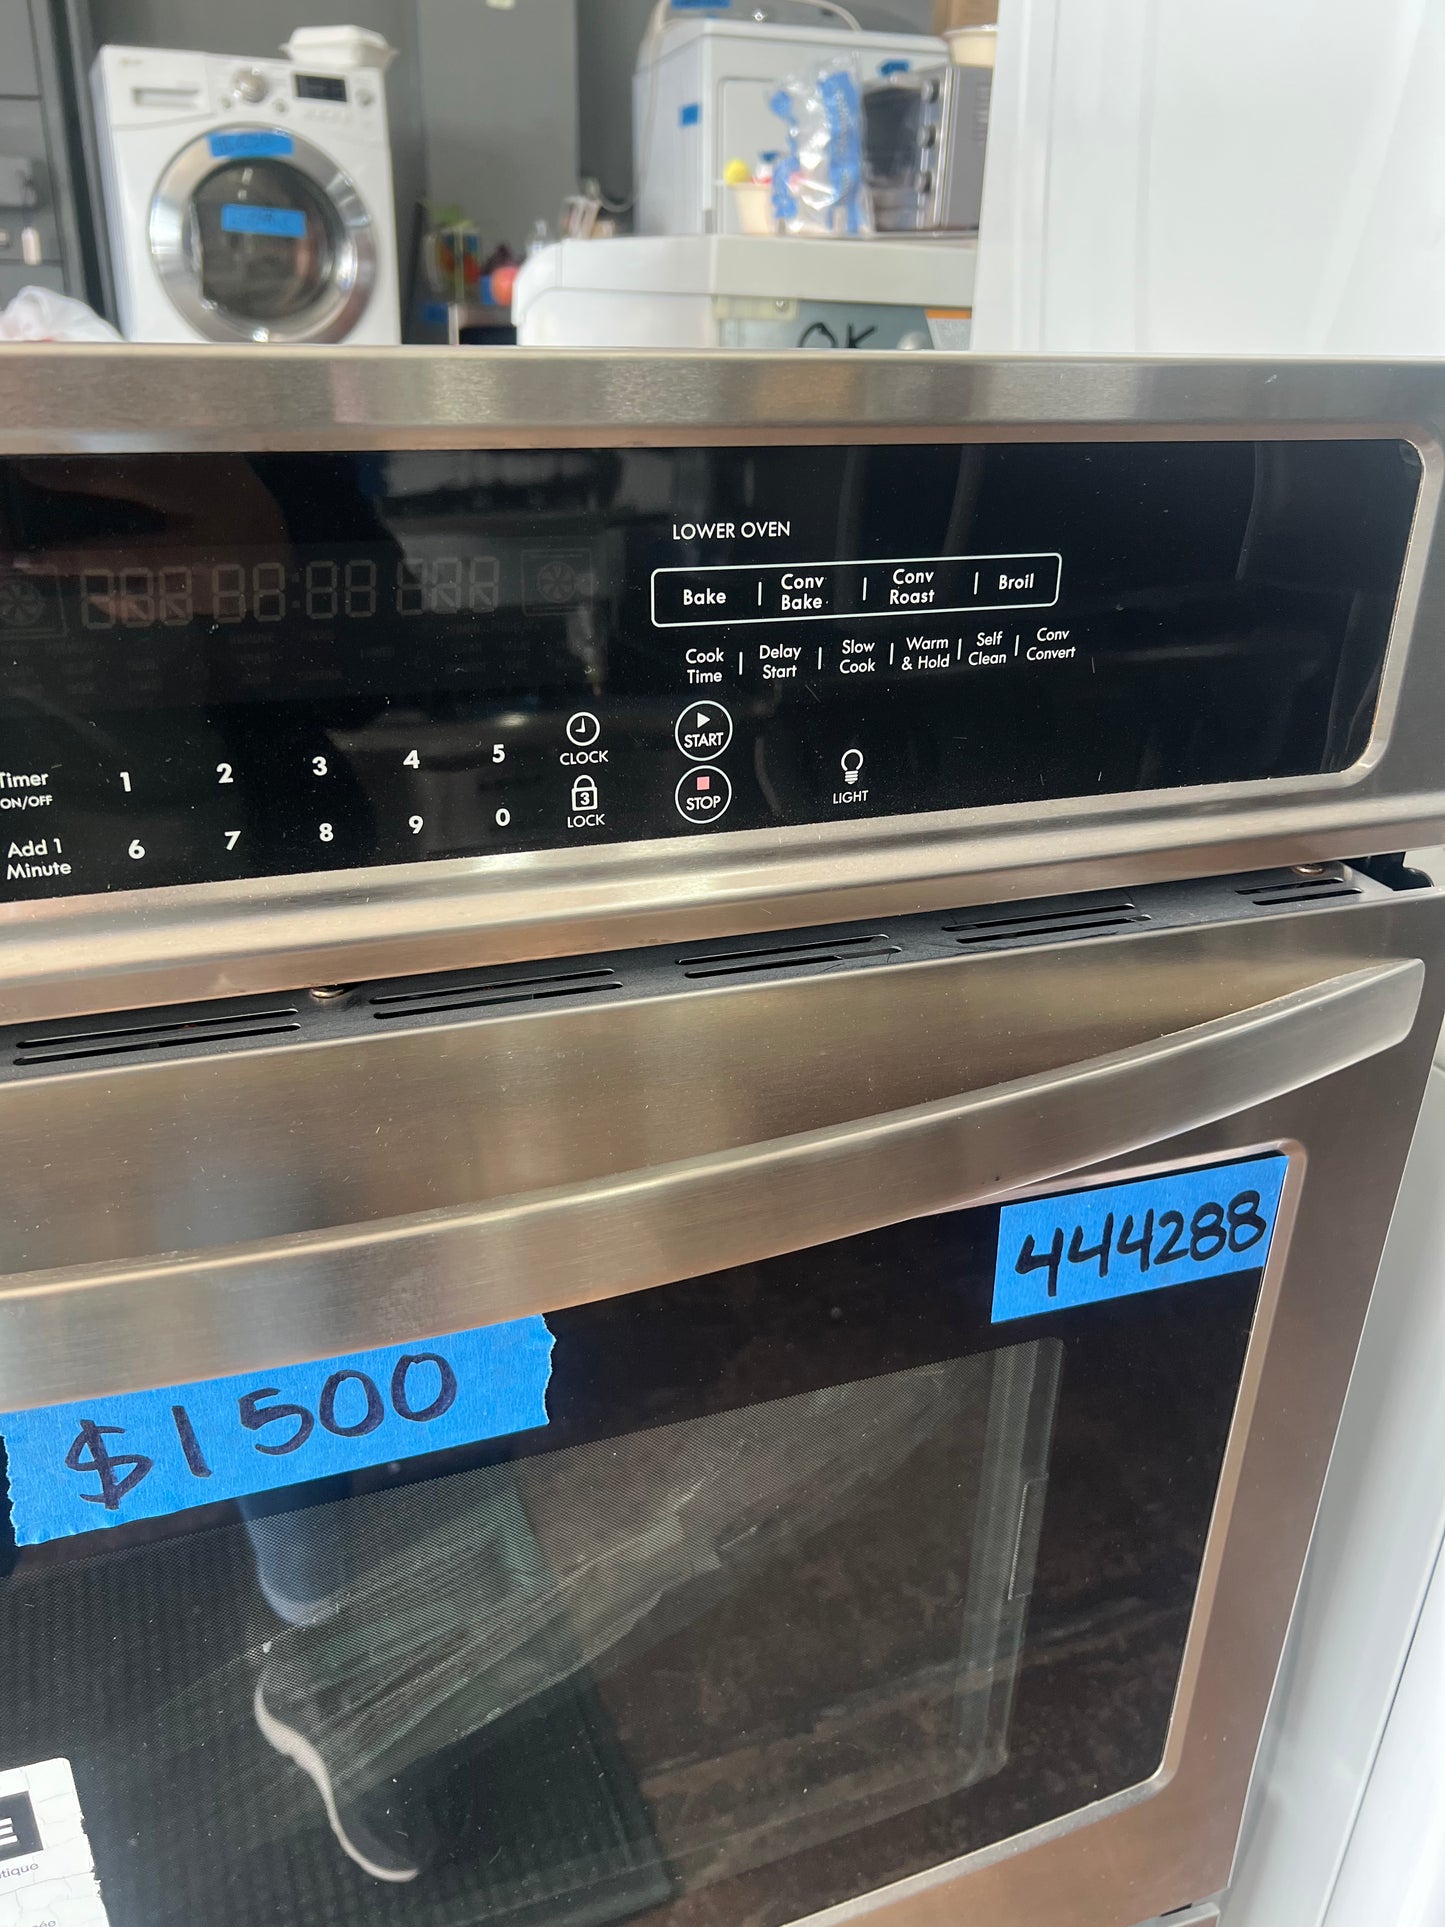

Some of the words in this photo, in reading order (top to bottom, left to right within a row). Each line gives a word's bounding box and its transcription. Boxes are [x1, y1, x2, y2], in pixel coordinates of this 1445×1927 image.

[672, 522, 736, 541] LOWER
[740, 520, 791, 540] OVEN
[780, 573, 825, 590] Conv
[892, 568, 935, 585] Conv
[998, 572, 1035, 590] Broil
[683, 587, 727, 606] Bake
[781, 593, 823, 611] Bake
[889, 588, 935, 605] Roast
[905, 635, 949, 651] Warm
[976, 630, 1004, 647] Self
[1036, 627, 1070, 642] Conv
[685, 647, 725, 664] Cook
[759, 643, 802, 662] Delay
[841, 639, 876, 655] Slow
[1026, 646, 1077, 662] Convert
[839, 657, 876, 674] Cook
[901, 656, 913, 671] &
[917, 653, 950, 670] Hold
[968, 650, 1007, 666] Clean
[686, 668, 723, 684] Time
[762, 664, 798, 680] Start
[683, 731, 724, 749] START
[559, 749, 609, 766] CLOCK
[119, 771, 132, 793] 1
[216, 762, 234, 784] 2
[311, 756, 328, 776] 3
[402, 749, 421, 769] 4
[492, 743, 506, 764] 5
[0, 771, 49, 789] Timer
[0, 794, 53, 811] ON/OFF
[580, 792, 590, 805] 3
[685, 794, 722, 812] STOP
[832, 789, 869, 805] LIGHT
[567, 813, 606, 829] LOCK
[128, 839, 146, 860] 6
[224, 830, 242, 851] 7
[319, 822, 334, 842] 8
[408, 815, 424, 834] 9
[495, 807, 511, 827] 0
[7, 838, 48, 859] Add
[53, 837, 63, 854] 1
[7, 861, 72, 880] Minute
[1014, 1189, 1267, 1298] 444288
[64, 1351, 458, 1510] $1500
[0, 1863, 39, 1879] tique
